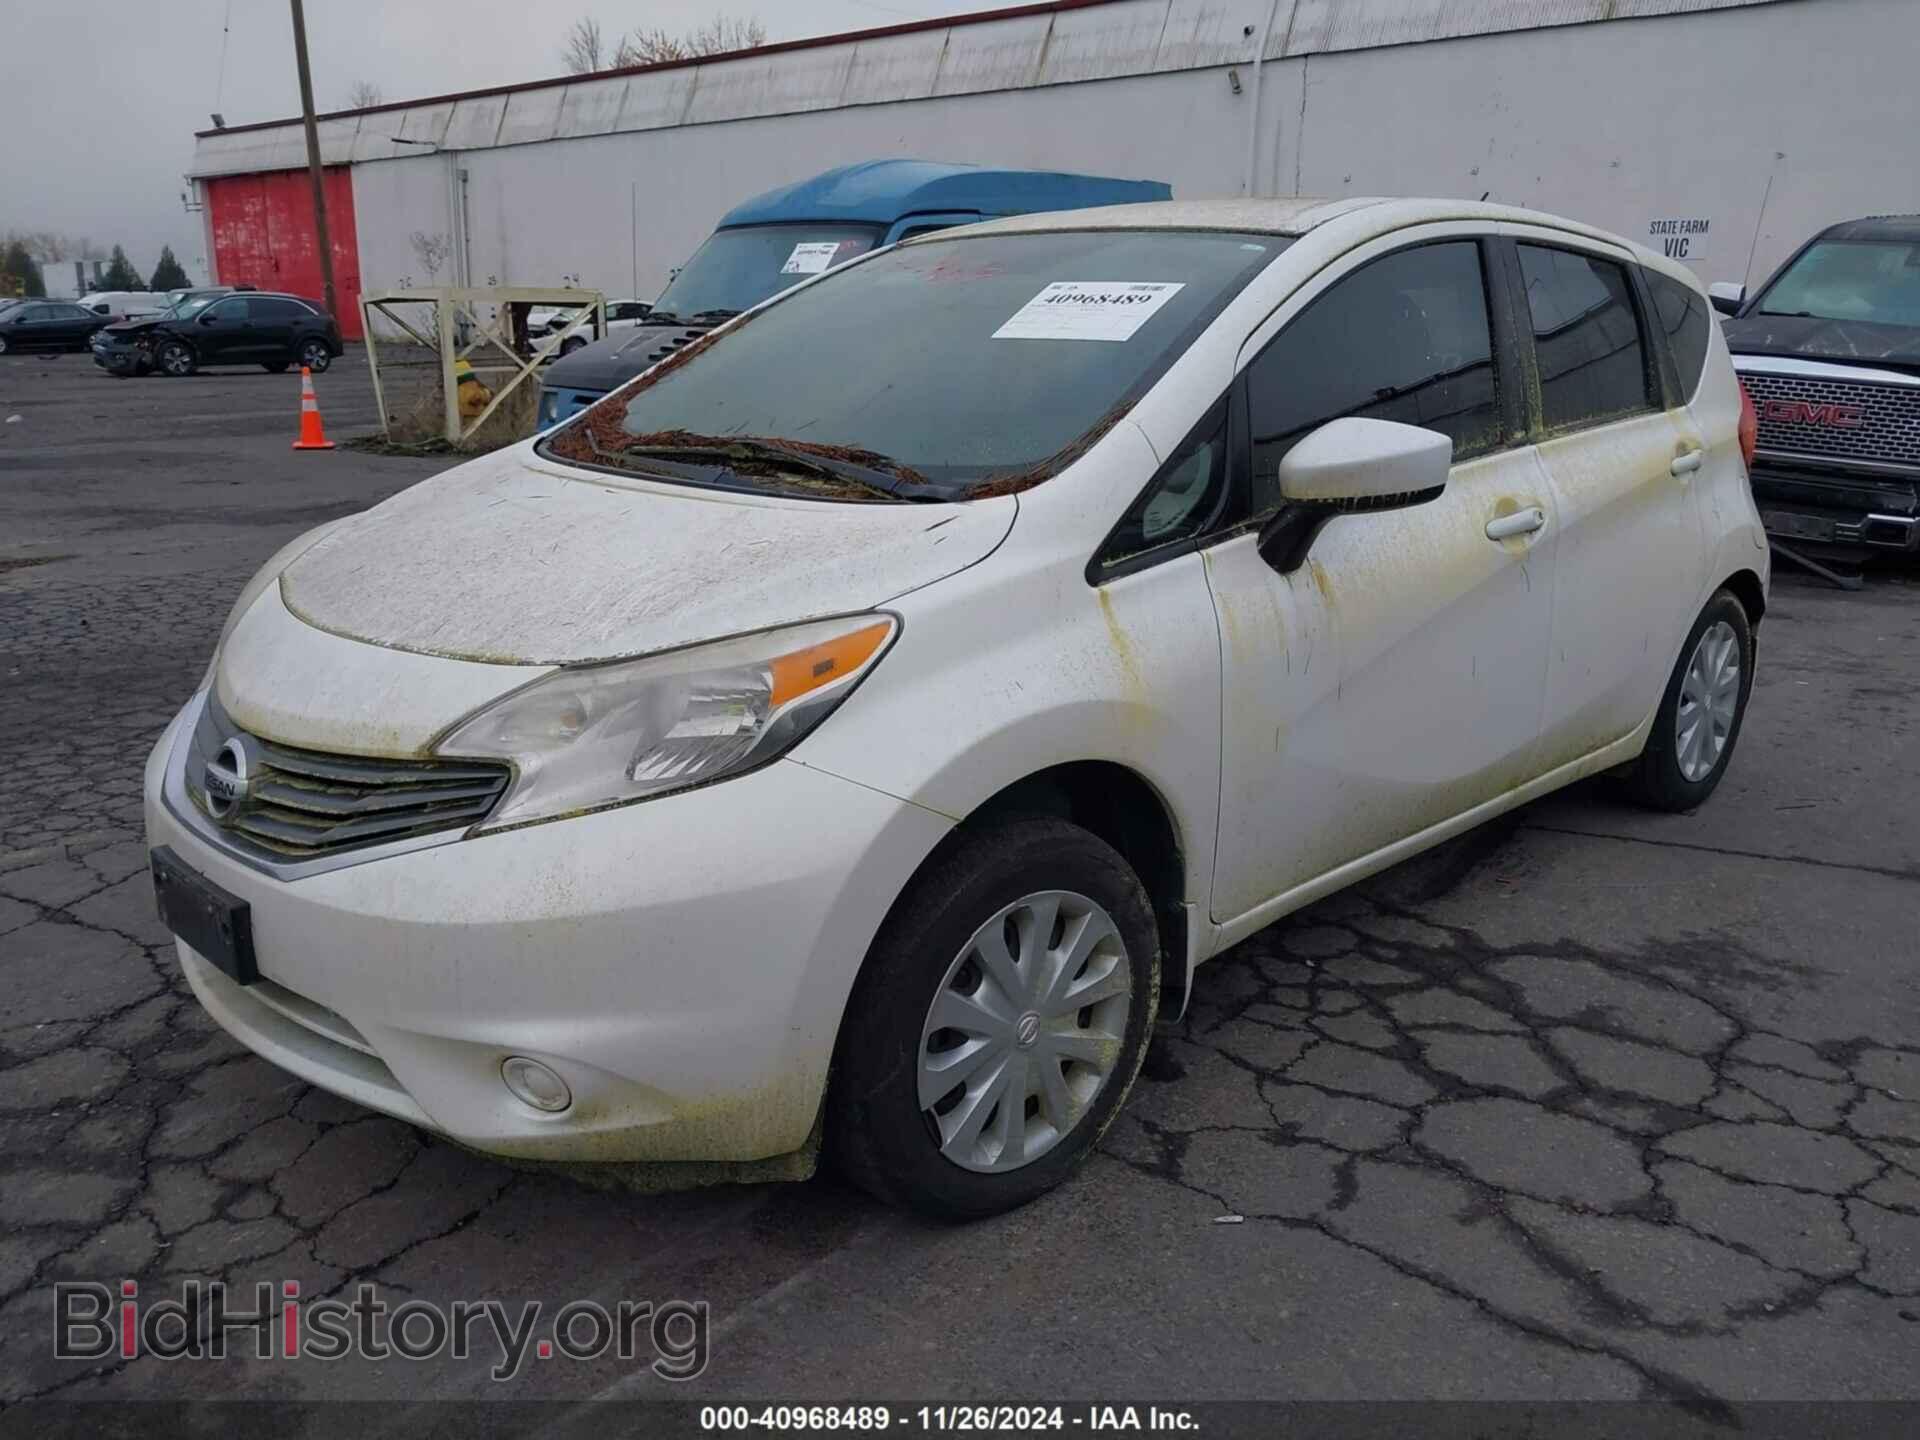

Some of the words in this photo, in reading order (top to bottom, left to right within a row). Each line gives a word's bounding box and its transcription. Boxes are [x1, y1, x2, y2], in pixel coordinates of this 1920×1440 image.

[1649, 220, 1678, 234] STATE
[1679, 219, 1709, 234] FARM
[1664, 238, 1689, 257] VIC
[1043, 293, 1153, 305] 40968489
[1763, 400, 1866, 429] GMC
